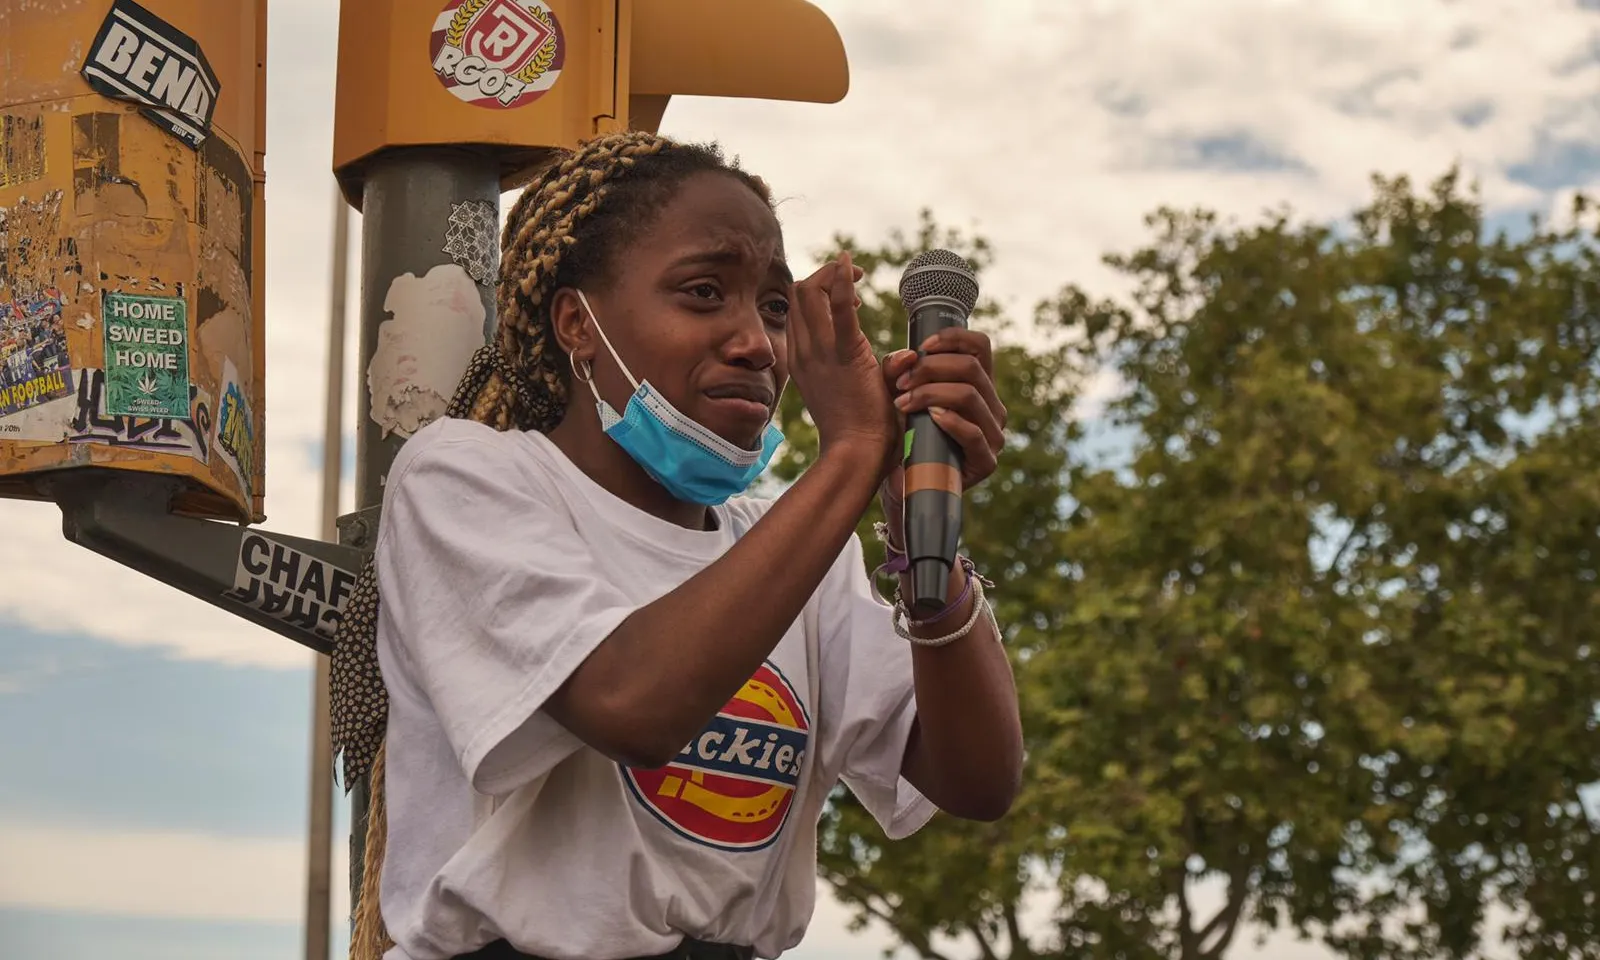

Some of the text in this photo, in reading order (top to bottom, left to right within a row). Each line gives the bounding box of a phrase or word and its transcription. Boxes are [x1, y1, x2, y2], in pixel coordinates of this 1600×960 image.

[95, 21, 209, 126] BEND
[114, 301, 176, 321] HOME
[109, 325, 183, 346] SWEED
[116, 350, 178, 370] HOME
[12, 369, 65, 404] FOOTBALL
[241, 534, 356, 607] CHAF
[680, 727, 805, 777] ckies
